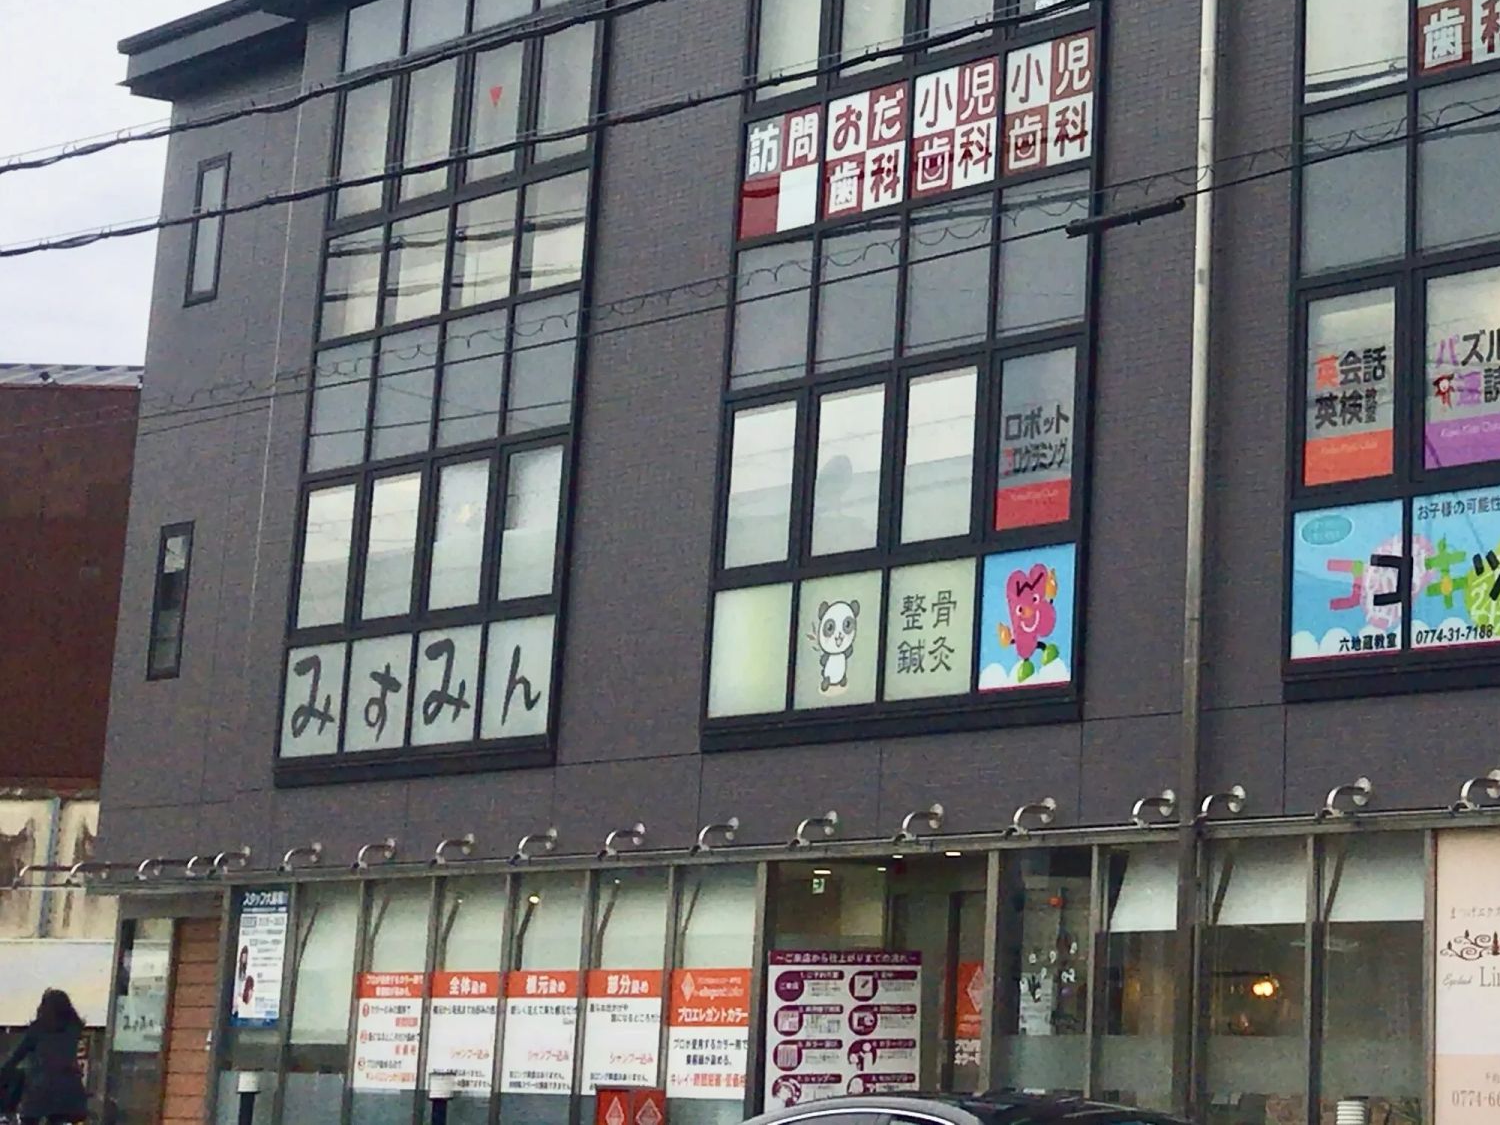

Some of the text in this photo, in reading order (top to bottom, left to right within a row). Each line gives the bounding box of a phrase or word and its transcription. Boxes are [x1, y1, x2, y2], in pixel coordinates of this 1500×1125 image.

[920, 61, 997, 126] 小児
[1010, 37, 1092, 104] 小児
[748, 112, 820, 176] 訪問
[833, 90, 906, 153] おだ
[1008, 103, 1090, 170] 歯科
[829, 150, 901, 212] 歯科
[916, 122, 994, 192] 歯科
[1315, 346, 1387, 391] 英会話
[1004, 403, 1070, 441] ロボット
[900, 589, 957, 631] 整骨
[1415, 624, 1494, 644] 0774-31-7188
[896, 637, 956, 675] 鍼灸
